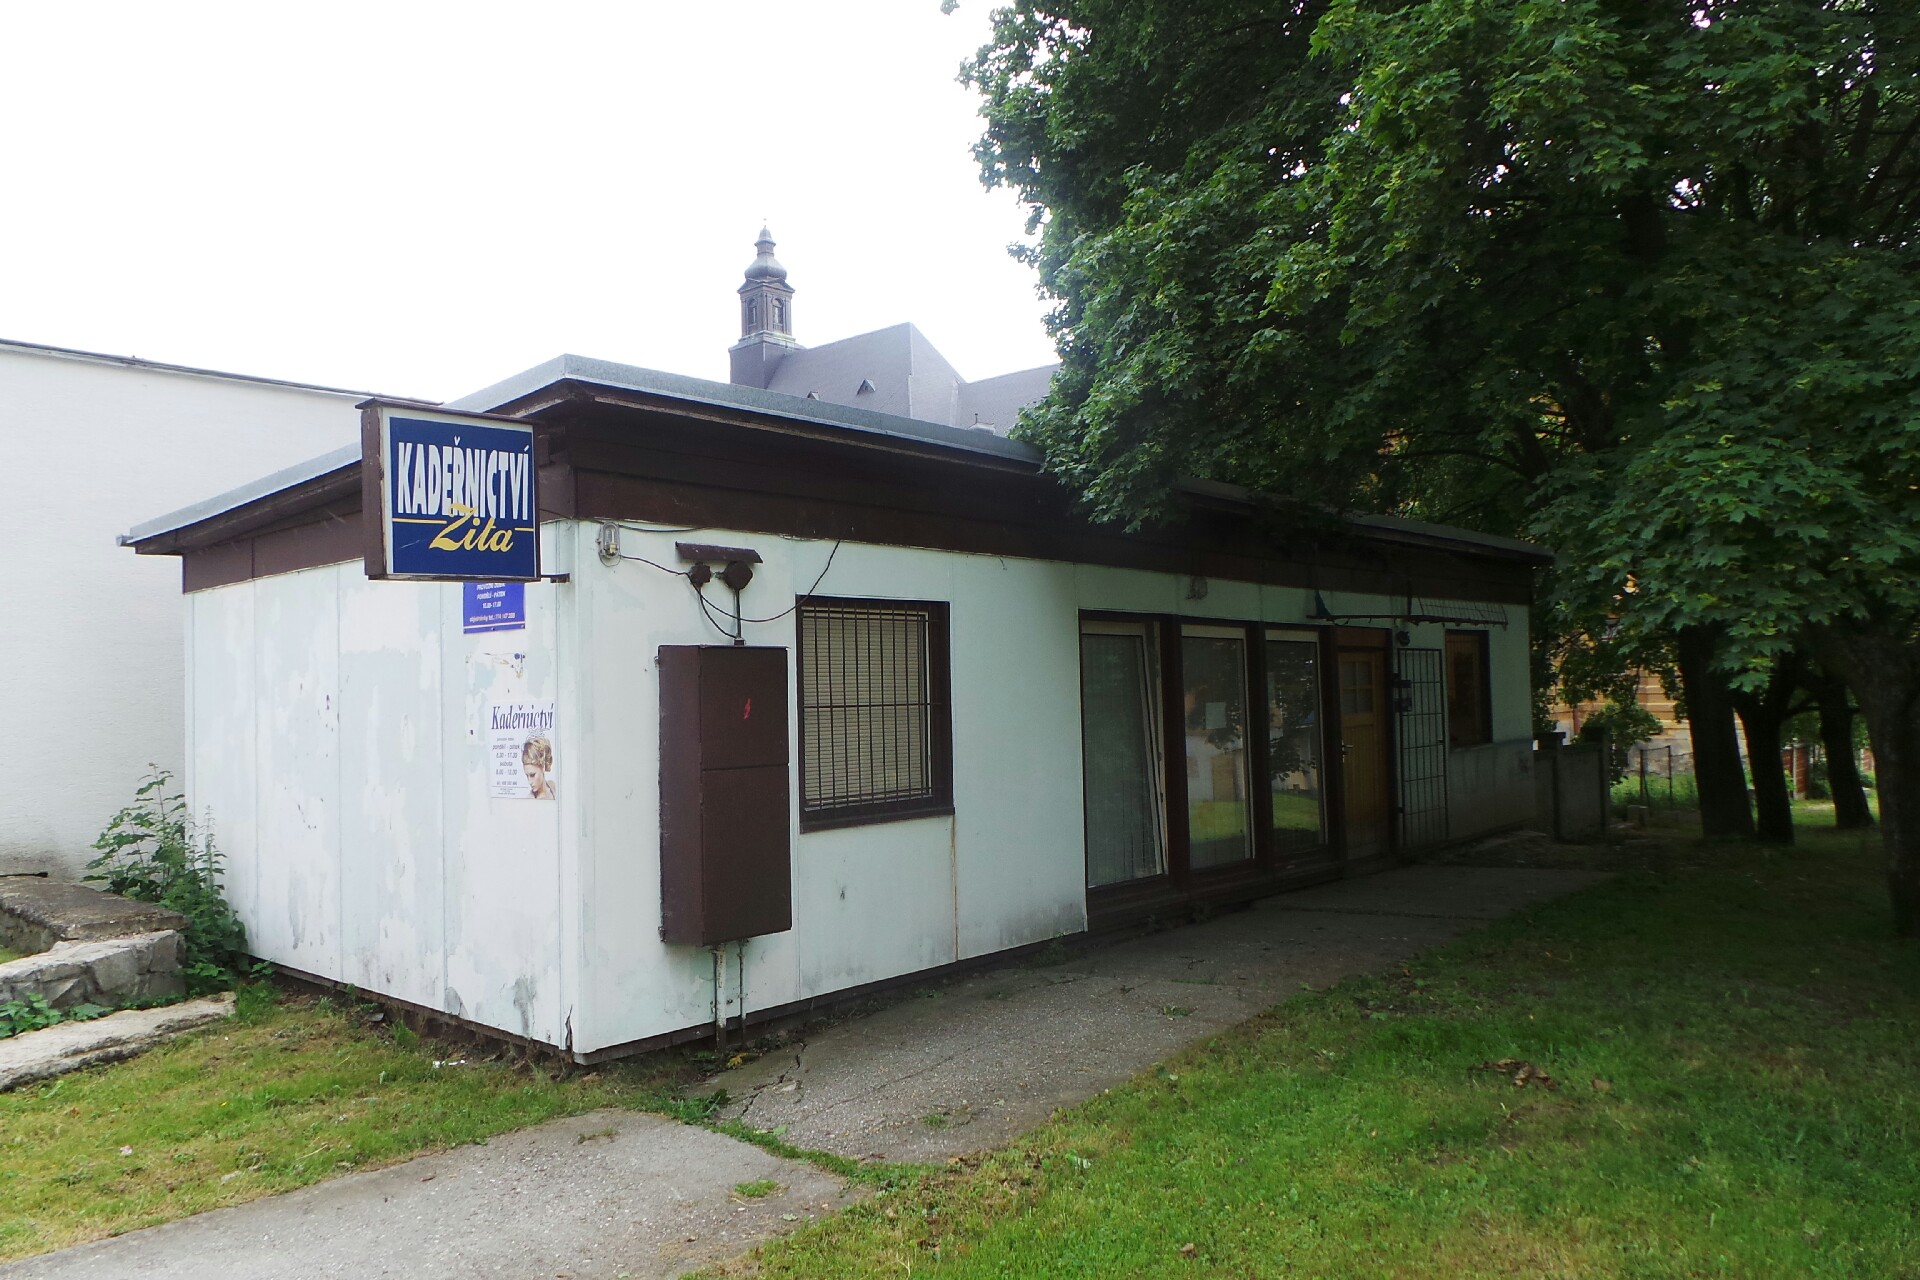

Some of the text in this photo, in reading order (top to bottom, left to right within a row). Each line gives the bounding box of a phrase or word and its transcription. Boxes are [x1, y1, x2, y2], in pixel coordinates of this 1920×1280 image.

[398, 435, 530, 520] KADEŘNICTVÍ
[429, 503, 514, 553] Zita
[491, 703, 554, 730] Kadeřnictví
